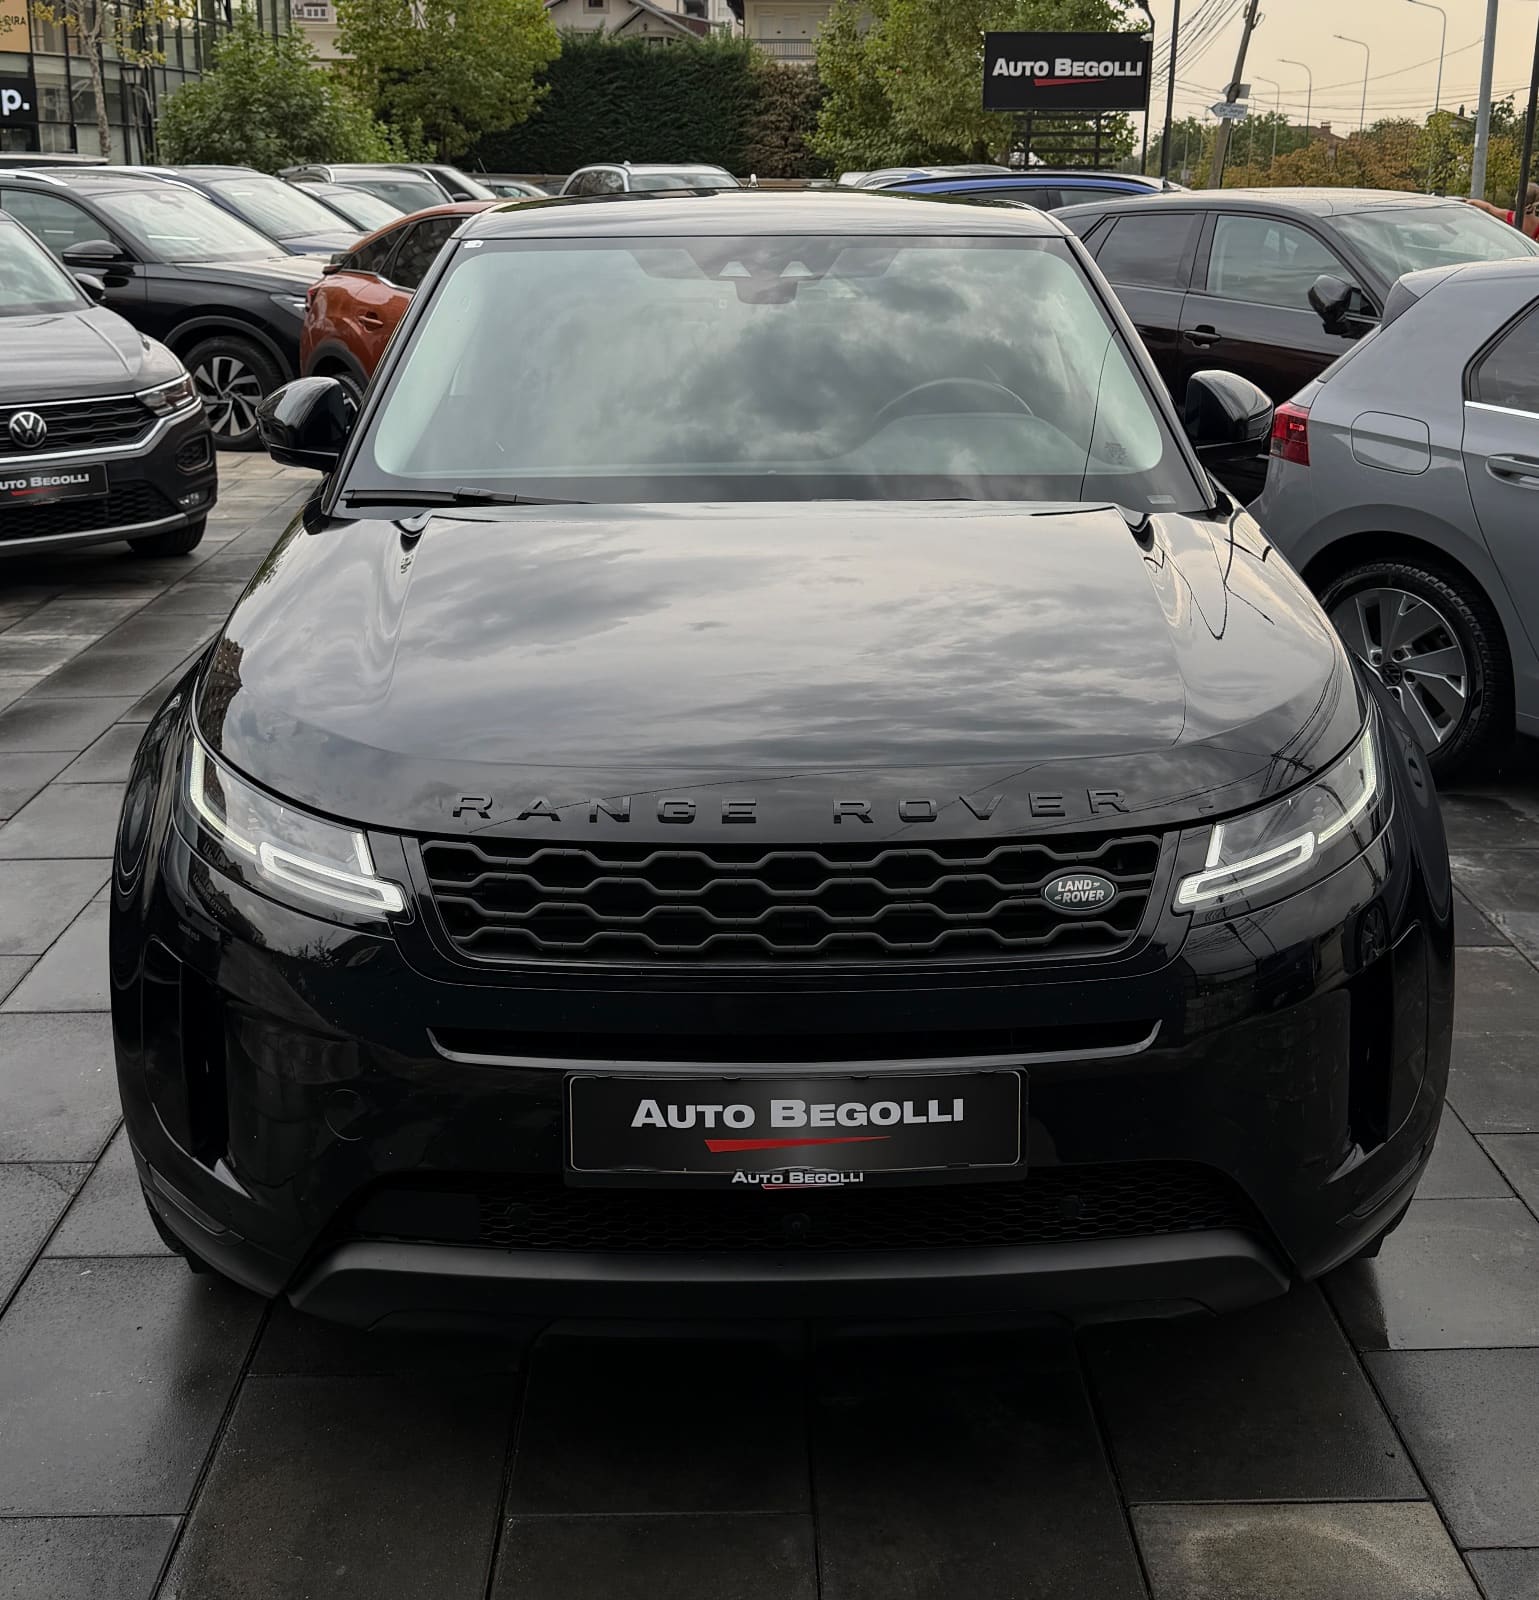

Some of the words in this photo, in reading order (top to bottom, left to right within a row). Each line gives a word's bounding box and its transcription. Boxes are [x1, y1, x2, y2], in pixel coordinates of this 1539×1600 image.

[992, 58, 1049, 77] AUTO
[1054, 58, 1143, 77] BEGOLLI
[0, 479, 27, 491] UTO
[30, 473, 90, 487] BEGOLLI
[452, 792, 758, 824] RANGE
[832, 788, 1130, 824] ROVER
[1057, 879, 1093, 892] LAND
[1062, 889, 1105, 904] ROVER
[630, 1098, 756, 1129] AUTO
[770, 1098, 965, 1129] BEGOLLI
[731, 1170, 784, 1185] AUTO
[788, 1170, 865, 1185] BEGOLLI
